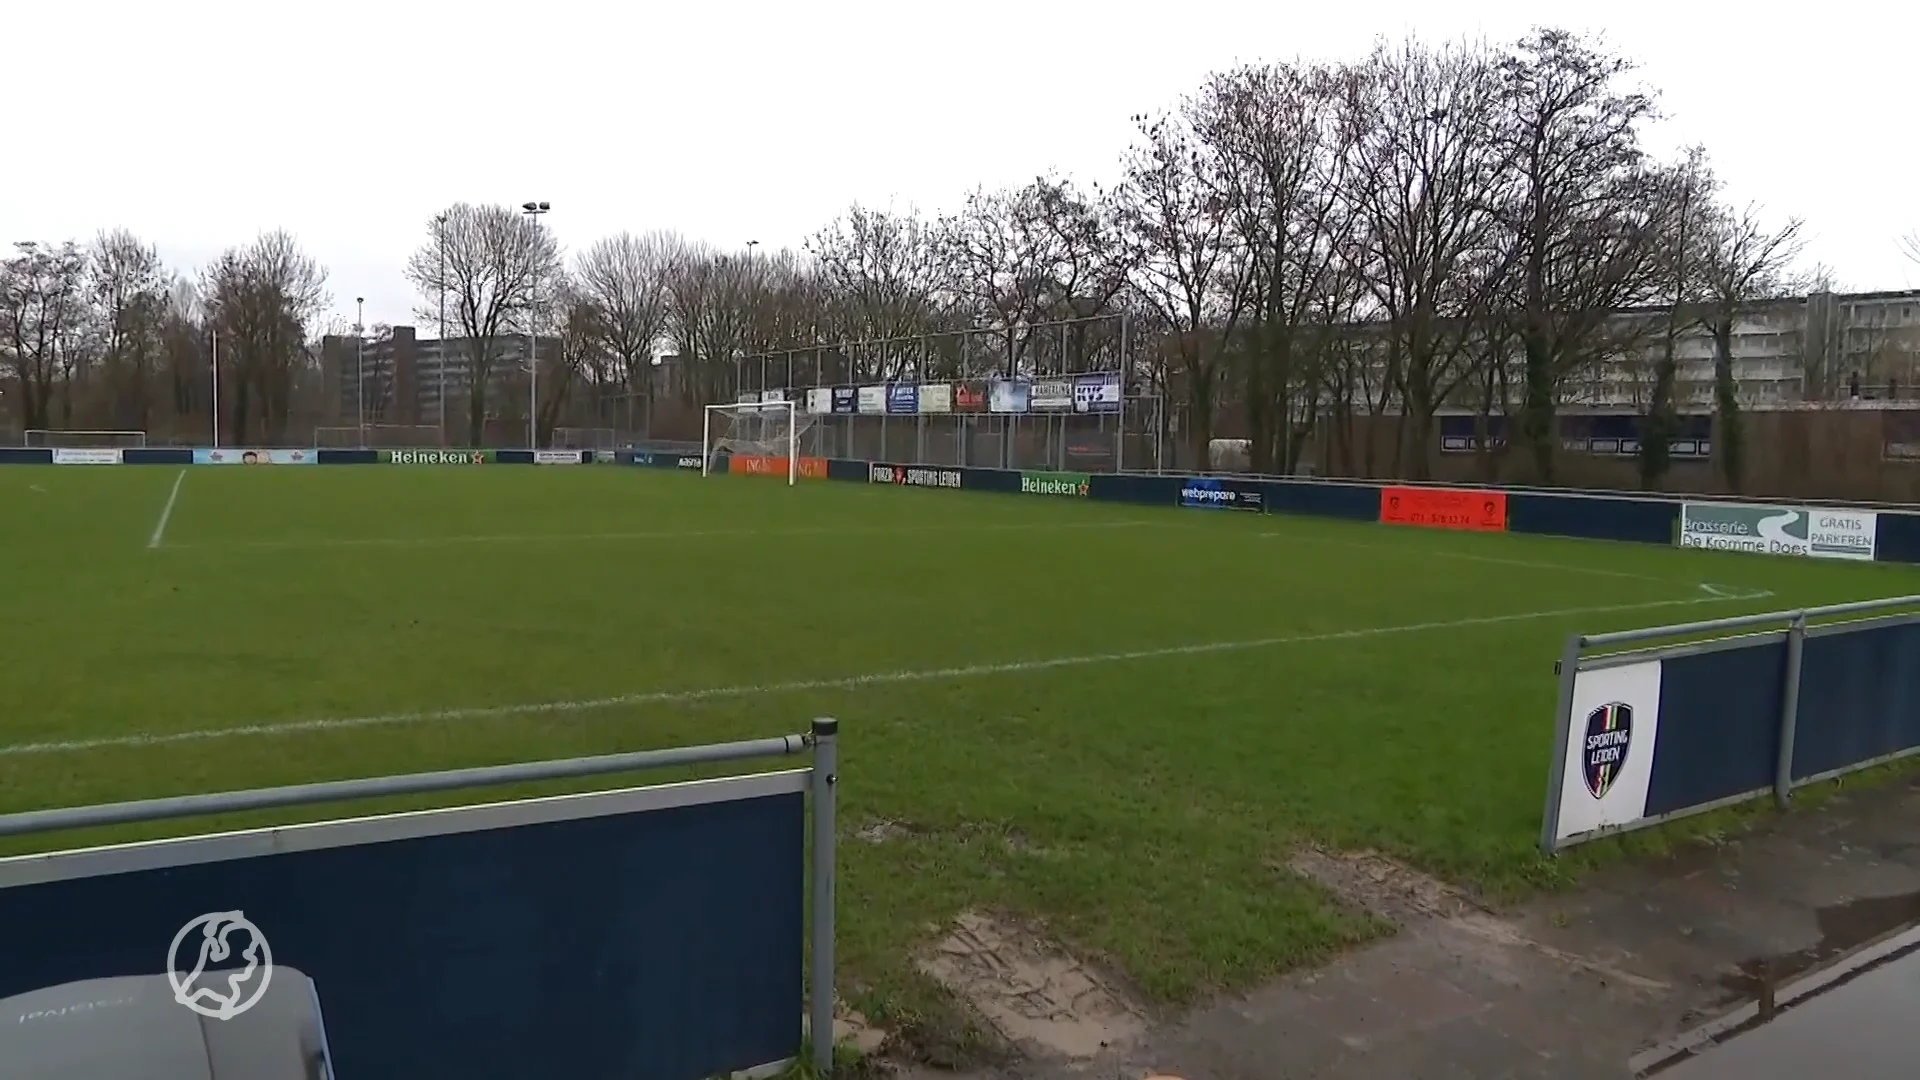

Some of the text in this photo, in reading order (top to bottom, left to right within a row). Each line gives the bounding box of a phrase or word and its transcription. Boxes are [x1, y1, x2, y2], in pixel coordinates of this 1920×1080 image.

[391, 450, 468, 465] Heineken
[1021, 477, 1076, 496] Heineken
[1181, 487, 1236, 502] webprepare
[1683, 518, 1748, 534] Brasserie
[1820, 516, 1862, 530] GRATIS
[1683, 533, 1807, 555] De Kromme Does
[1811, 532, 1872, 546] PARKEREN
[1587, 730, 1628, 749] SPORTING
[1591, 747, 1620, 765] LEIDEN
